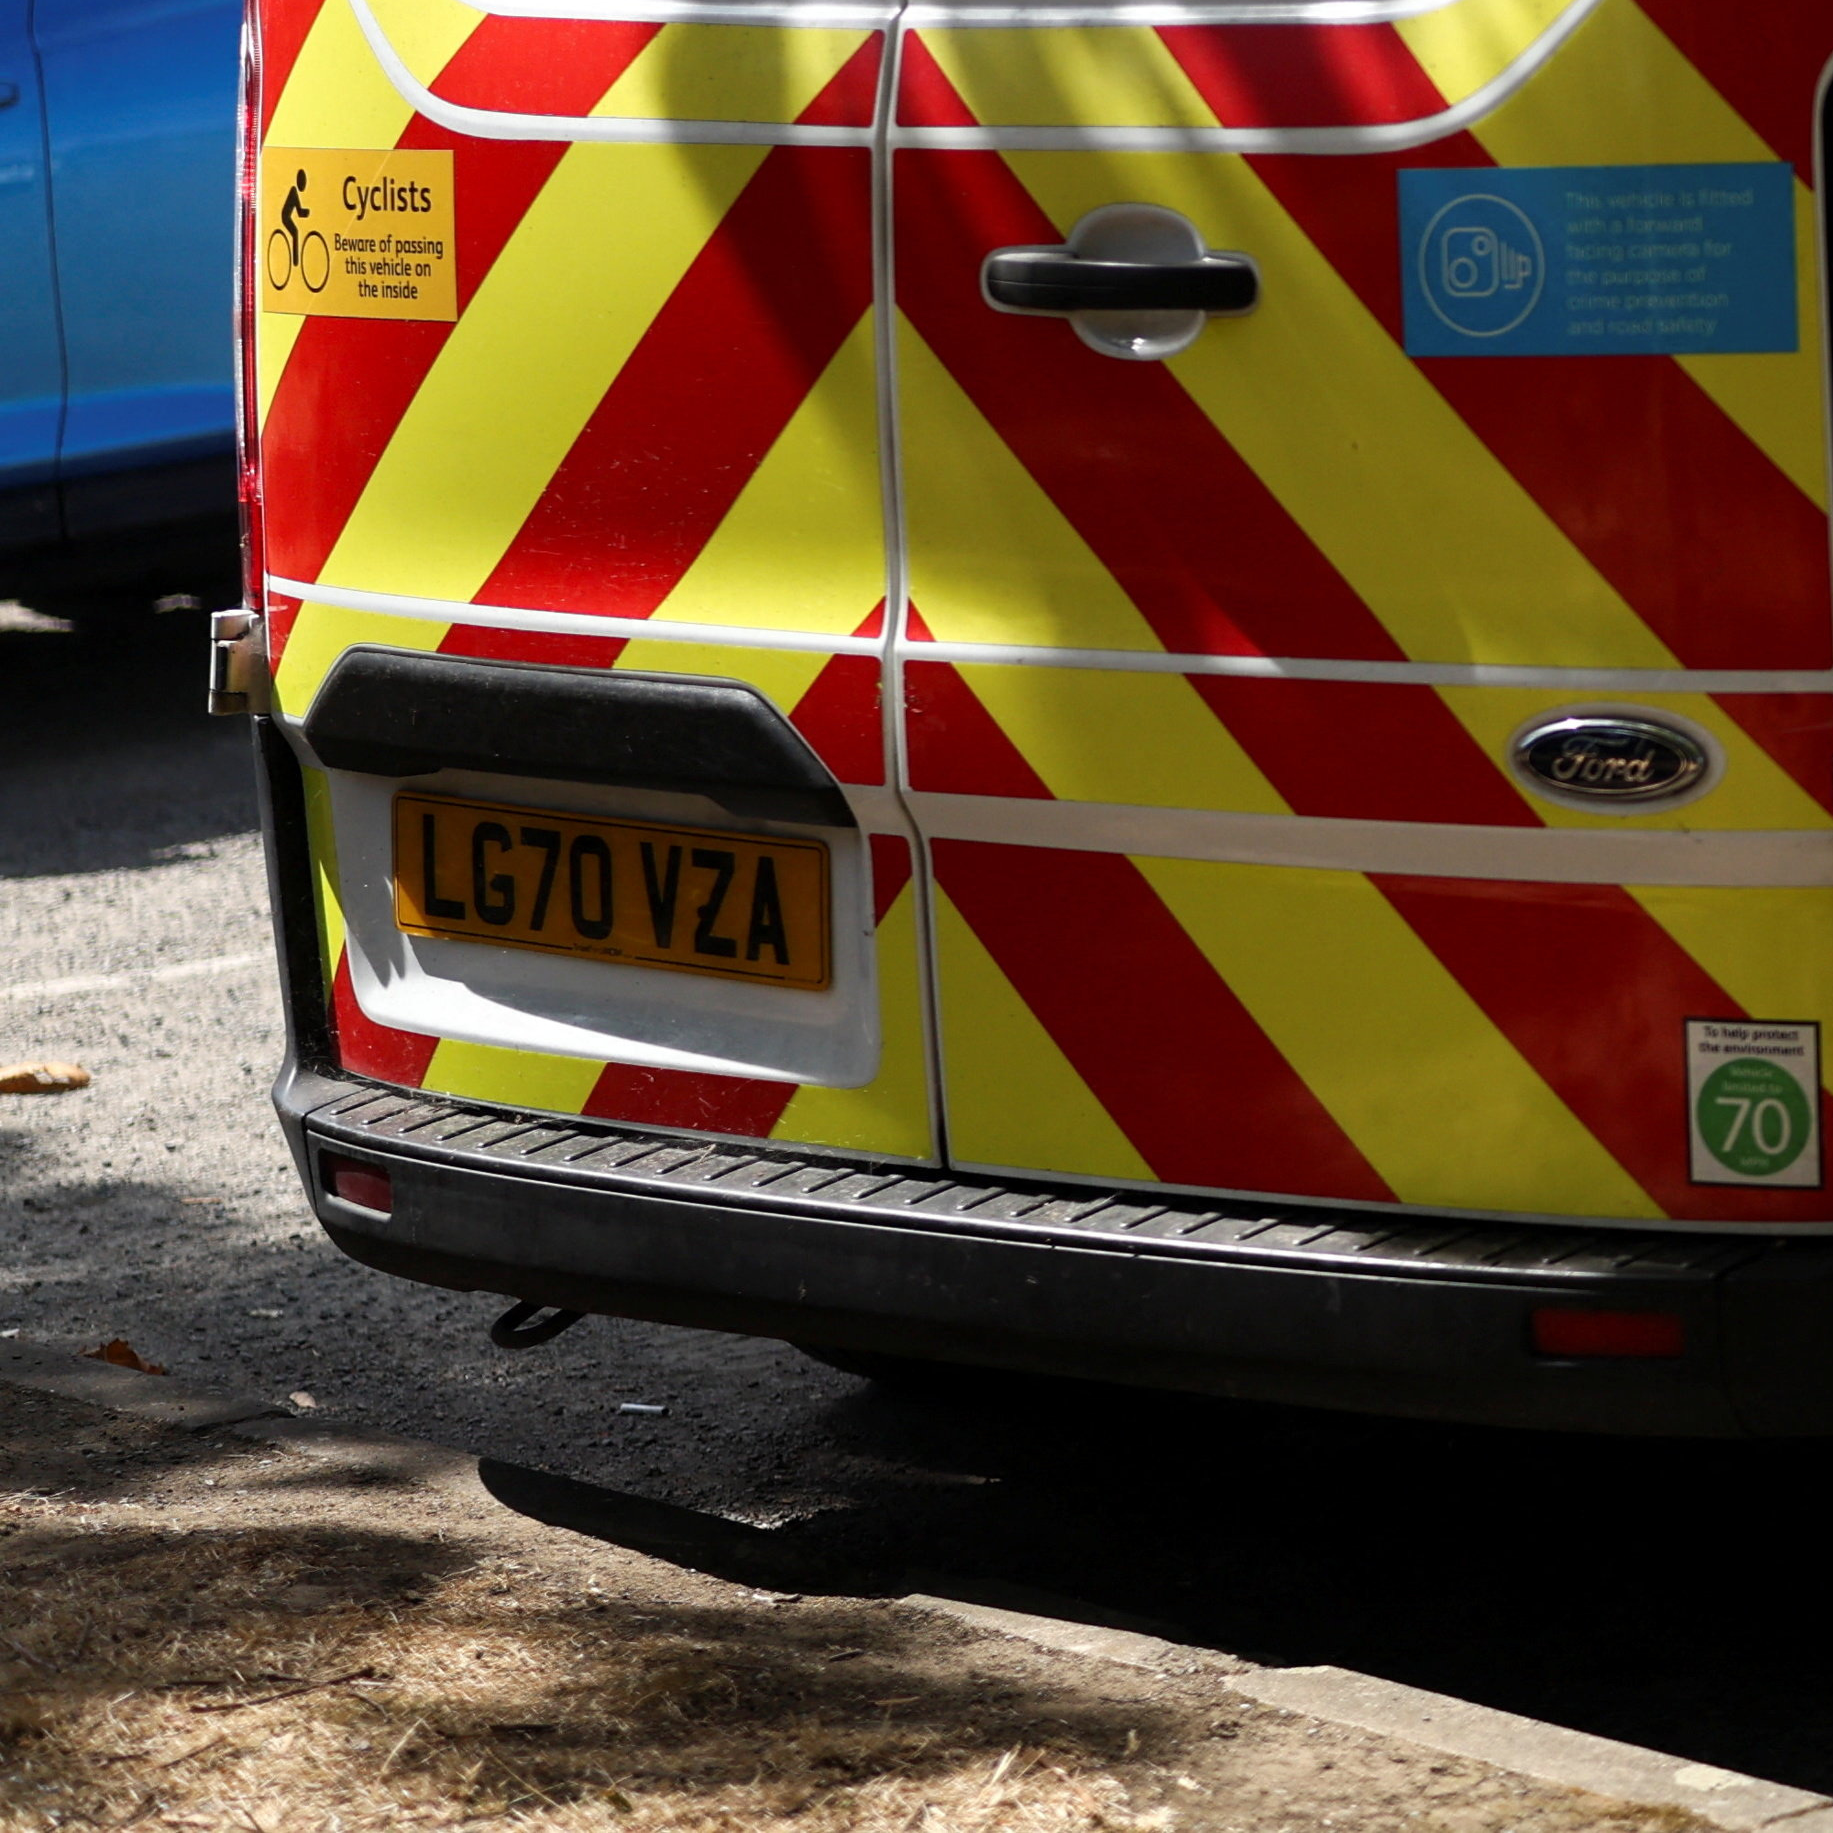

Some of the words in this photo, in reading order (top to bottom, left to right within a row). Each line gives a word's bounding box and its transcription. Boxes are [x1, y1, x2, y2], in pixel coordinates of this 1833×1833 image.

[342, 175, 432, 221] Cyclists
[334, 233, 376, 253] Beware
[379, 234, 393, 253] of
[396, 236, 443, 259] passing
[345, 256, 367, 275] this
[369, 257, 411, 276] vehicle
[415, 262, 431, 276] on
[358, 279, 378, 298] the
[381, 280, 418, 299] inside
[1552, 735, 1657, 783] Ford
[422, 813, 615, 941] LG70
[639, 841, 790, 966] VZA
[1715, 1097, 1792, 1156] 70
